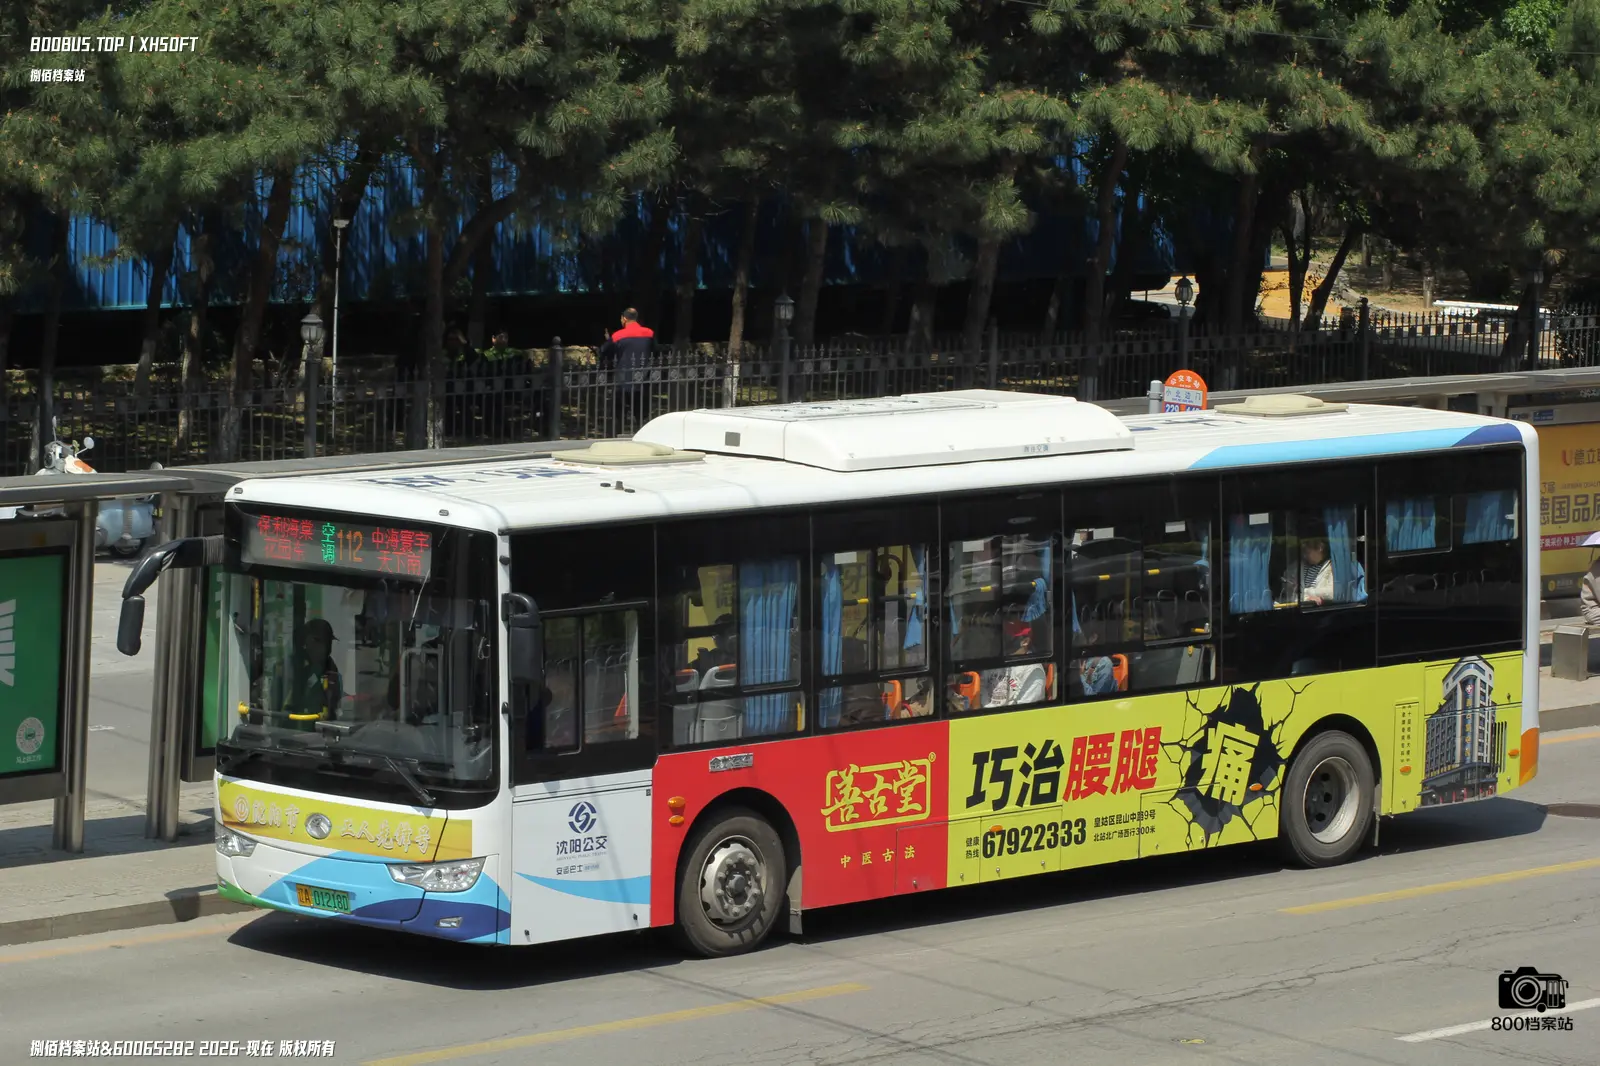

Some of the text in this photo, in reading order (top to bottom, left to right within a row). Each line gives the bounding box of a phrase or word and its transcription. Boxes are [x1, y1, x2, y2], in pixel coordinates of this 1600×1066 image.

[321, 522, 335, 564] 空调
[337, 529, 363, 563] 112
[371, 527, 430, 553] 中海寰宇
[556, 836, 607, 856] 沈阳公交
[982, 818, 1087, 859] 67922333
[840, 846, 916, 869] 中医古法
